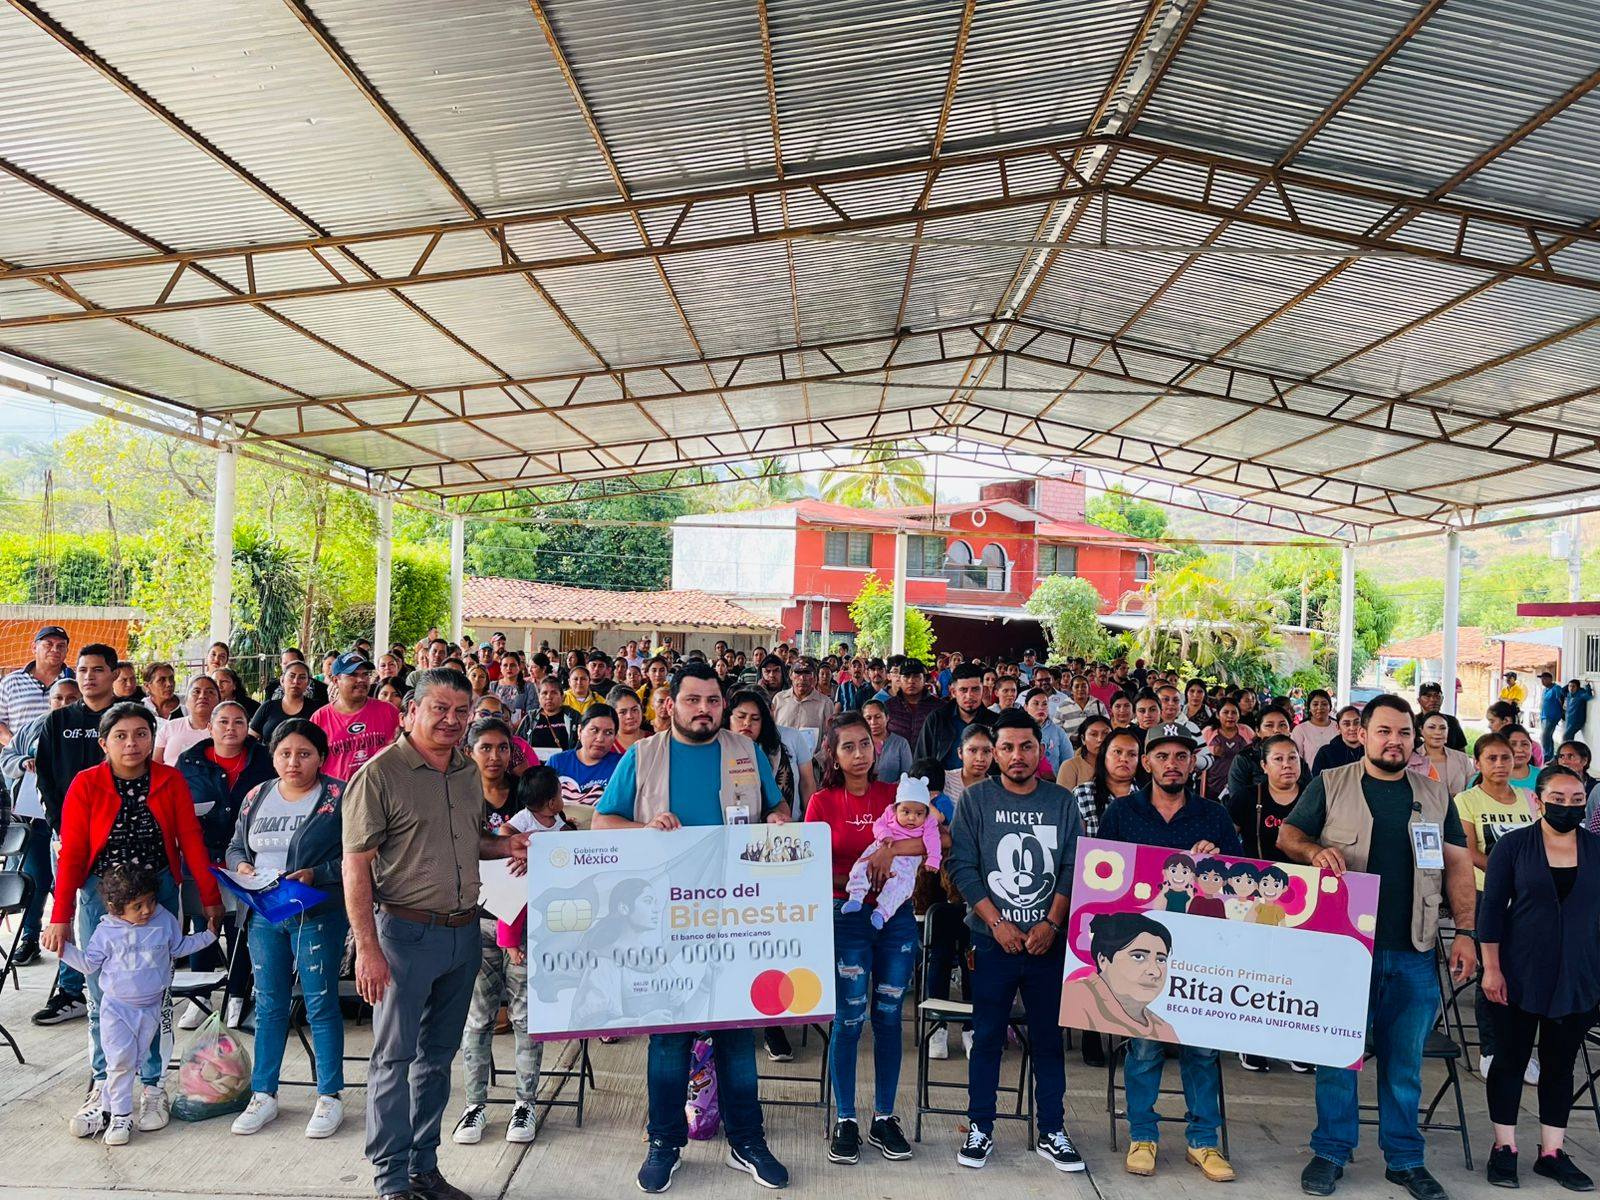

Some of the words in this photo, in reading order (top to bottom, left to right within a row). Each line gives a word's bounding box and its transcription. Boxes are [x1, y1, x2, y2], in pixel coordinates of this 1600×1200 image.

[63, 728, 101, 738] Off-Whi
[1163, 724, 1179, 736] NY
[252, 815, 291, 835] OMMY
[995, 810, 1044, 825] MICKEY
[1481, 813, 1513, 823] SHUT
[573, 853, 619, 865] México
[670, 887, 727, 901] Banco
[732, 883, 760, 898] del
[670, 901, 819, 929] Bienestar
[1001, 908, 1046, 923] MOUSE
[671, 934, 679, 942] El
[680, 933, 704, 941] banco
[717, 931, 729, 939] los
[730, 930, 771, 938] mexicanos
[542, 950, 599, 973] 0000
[613, 946, 668, 967] 0000
[682, 942, 735, 964] 0000
[749, 939, 801, 960] 0000
[1170, 959, 1234, 978] Educación
[1237, 968, 1293, 986] Primaria
[1168, 975, 1223, 1004] Rita
[1230, 984, 1319, 1018] Cetina
[1166, 1003, 1190, 1013] BECA
[1191, 1007, 1203, 1016] DE
[1204, 1009, 1237, 1021] APOYO
[1238, 1014, 1263, 1024] PARA
[1265, 1017, 1320, 1033] UNIFORMES
[1322, 1026, 1329, 1034] Y
[1330, 1025, 1362, 1039] ÚTILES
